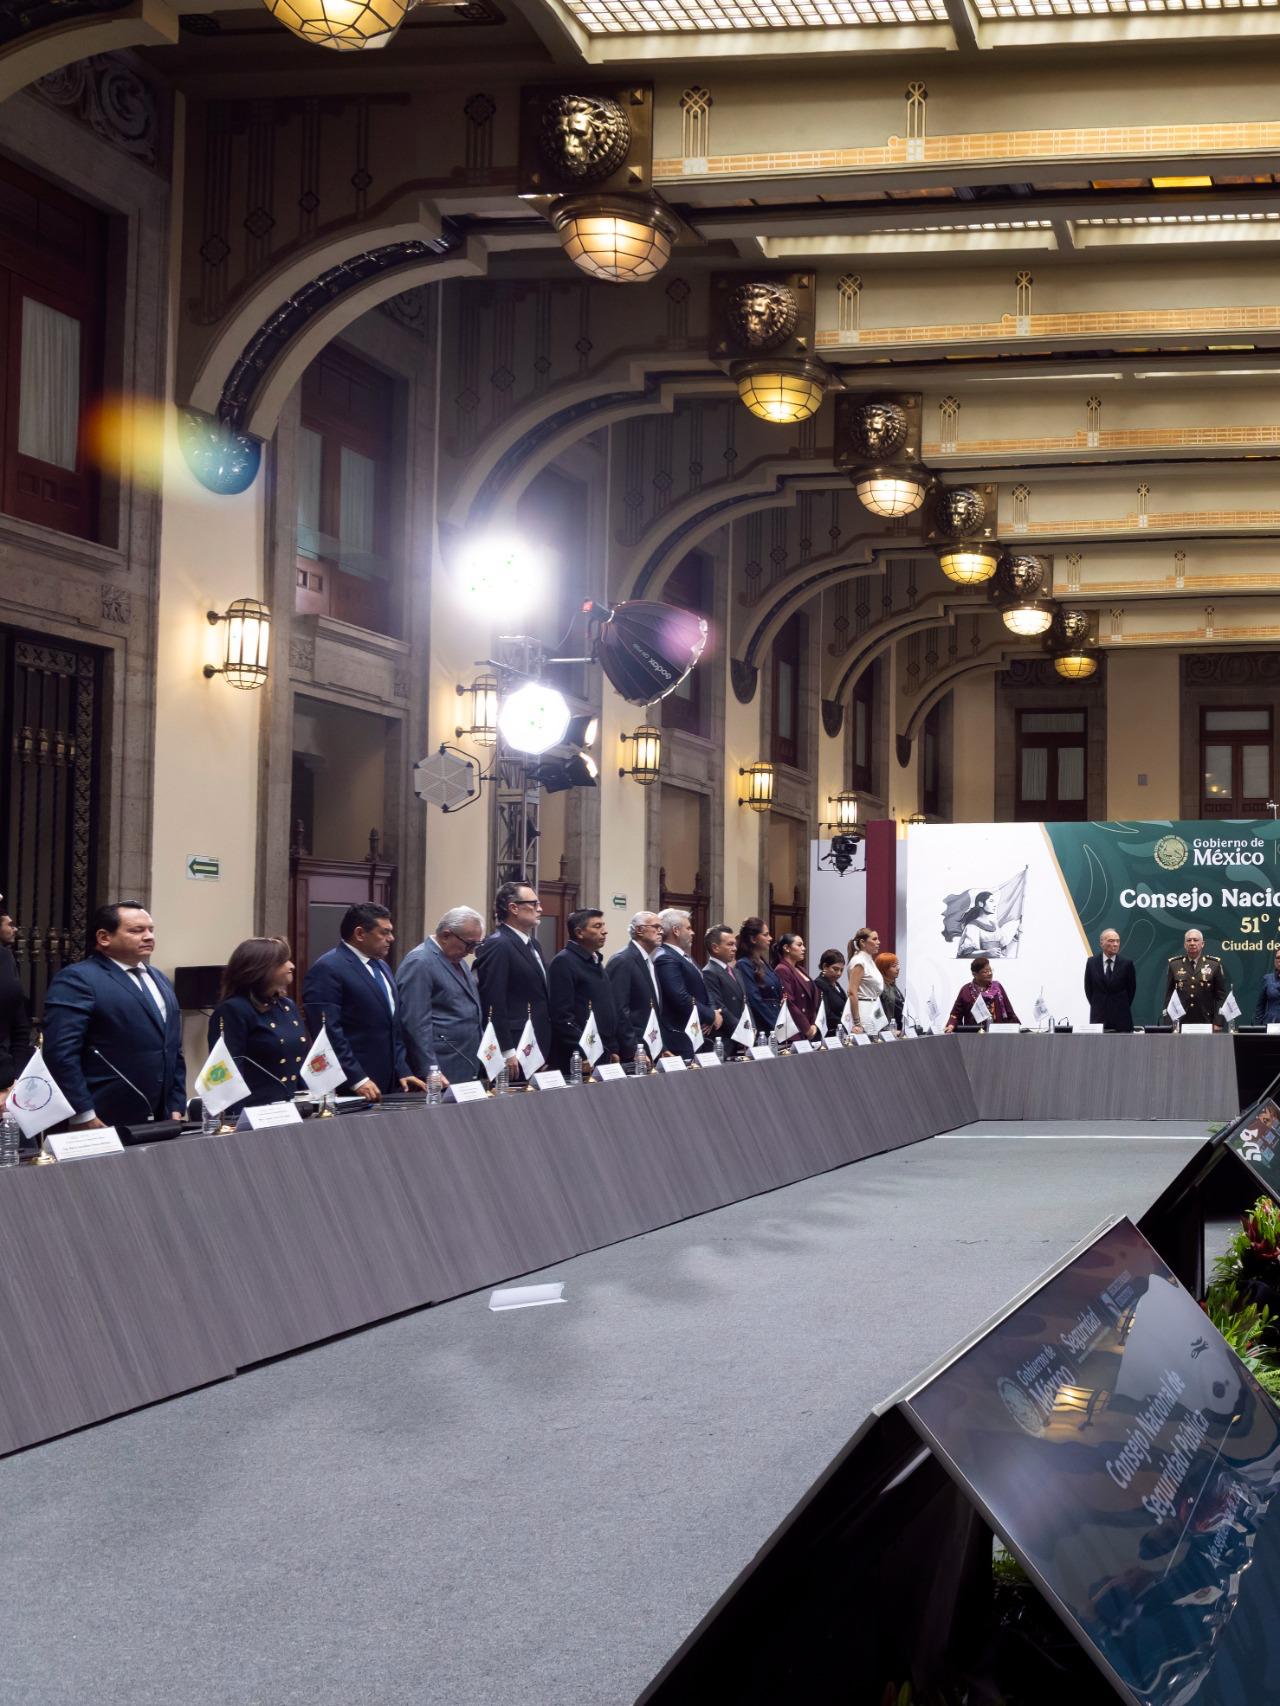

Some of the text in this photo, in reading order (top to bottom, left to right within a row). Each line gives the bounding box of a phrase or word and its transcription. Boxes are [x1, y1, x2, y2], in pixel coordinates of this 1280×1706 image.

[1193, 837, 1265, 848] Gobierno de
[1193, 847, 1264, 866] México
[1119, 888, 1213, 911] Consejo
[1221, 940, 1263, 951] Ciudad
[1266, 939, 1280, 950] de
[1106, 1368, 1186, 1489] Consejo Nacional de
[1141, 1408, 1210, 1525] Seguridad Pública
